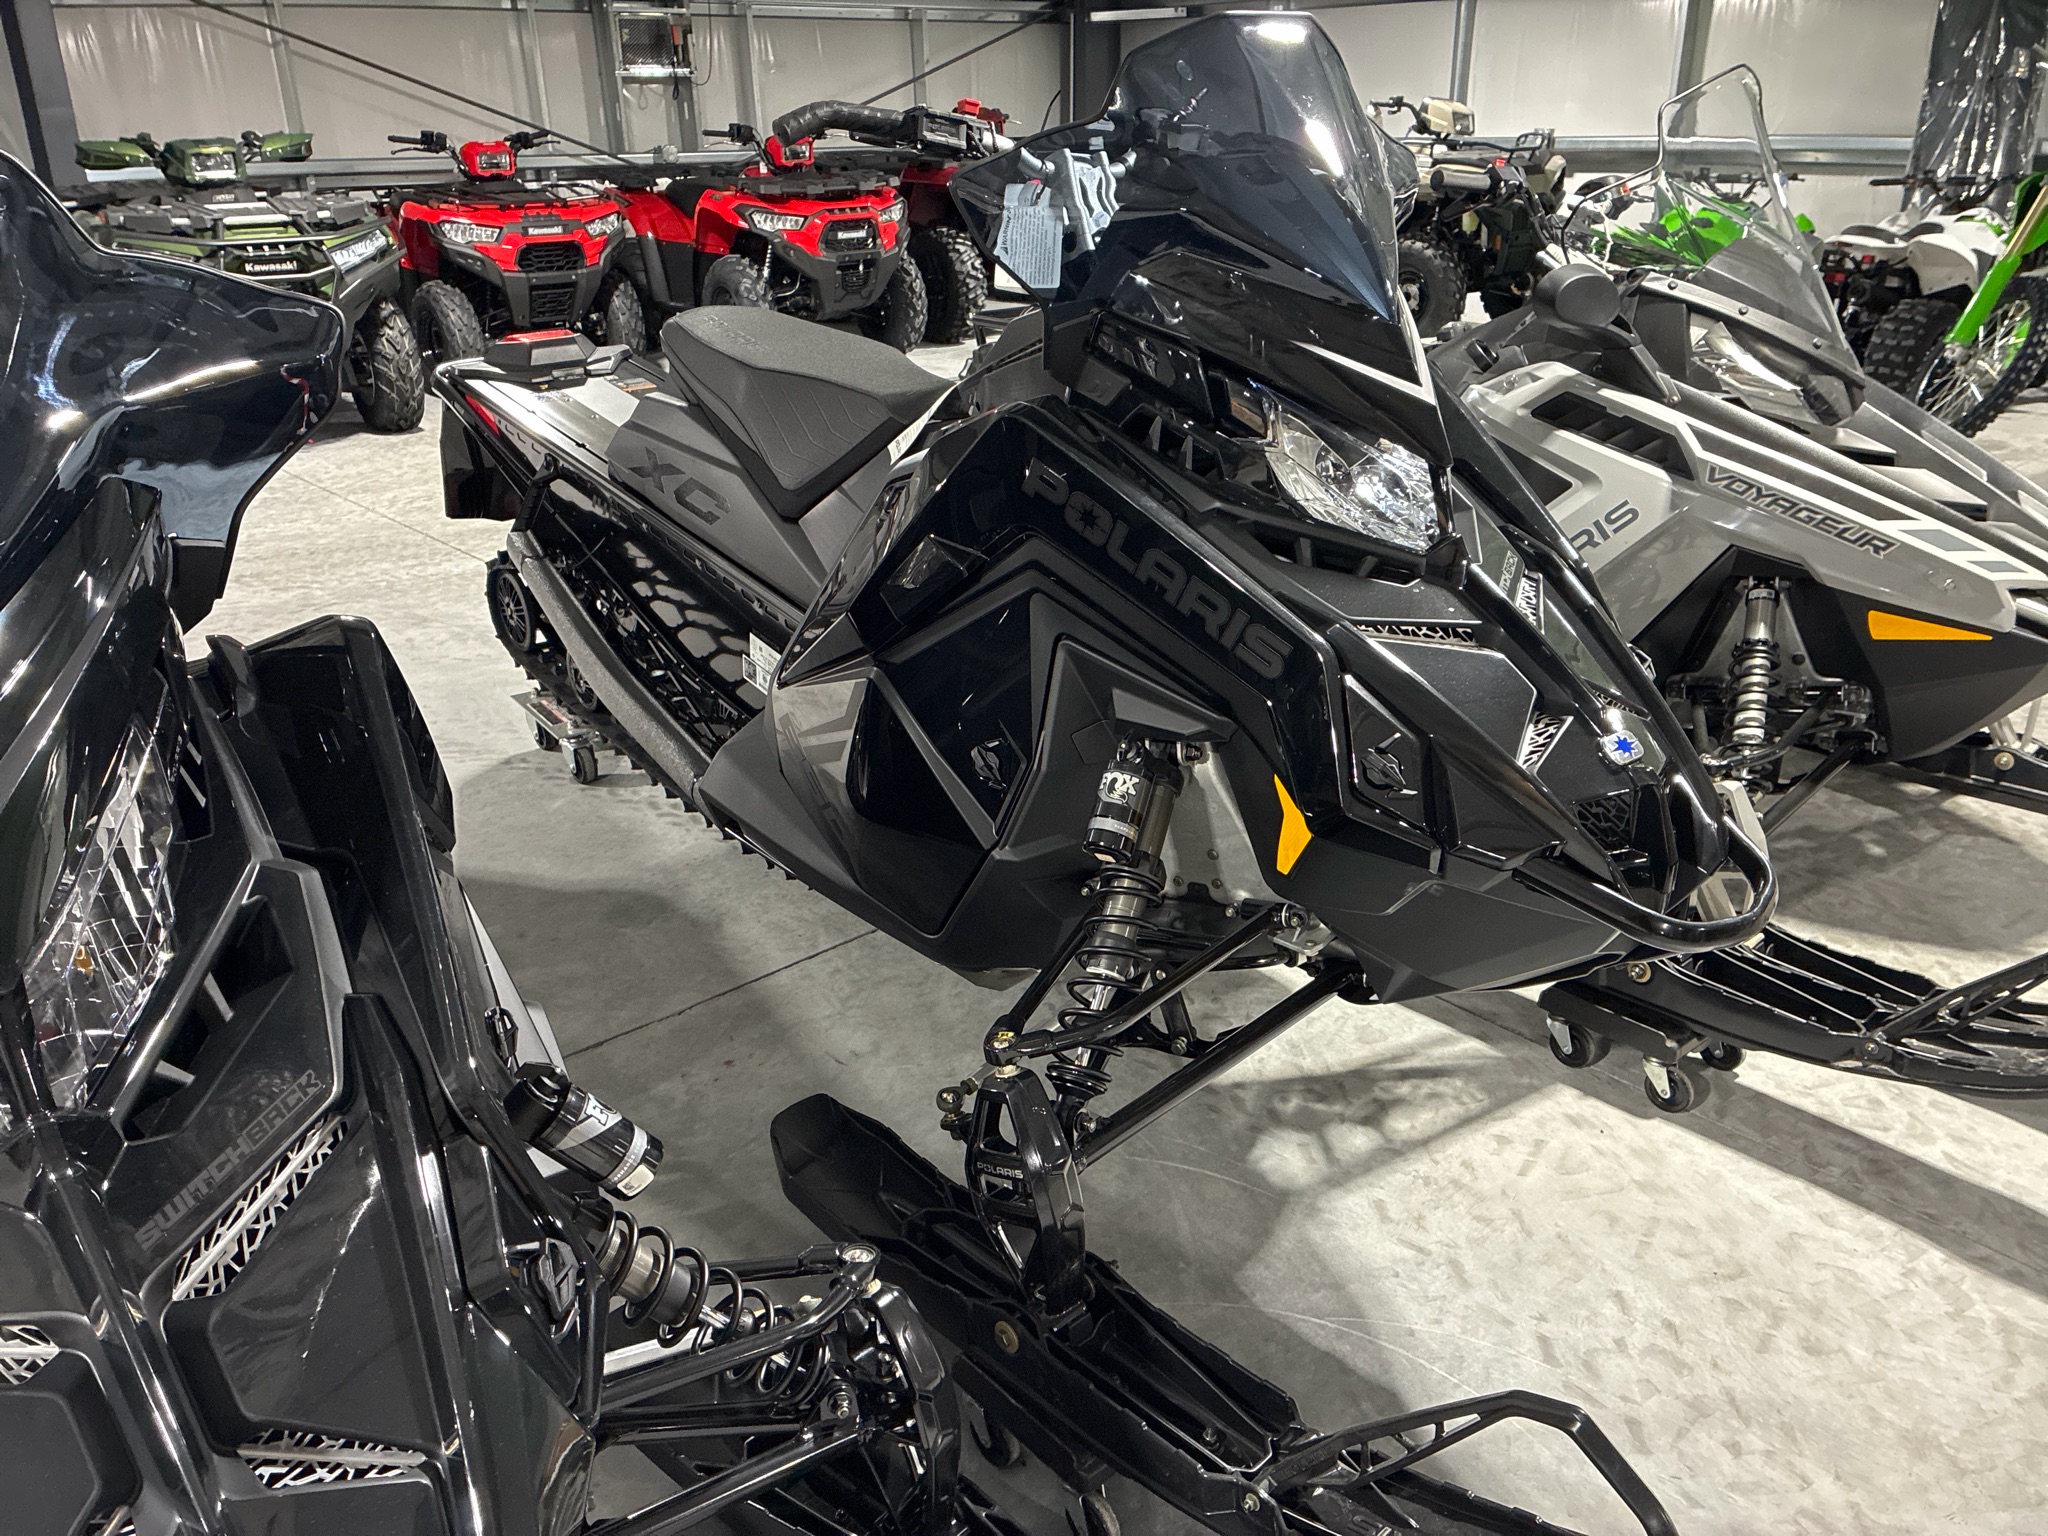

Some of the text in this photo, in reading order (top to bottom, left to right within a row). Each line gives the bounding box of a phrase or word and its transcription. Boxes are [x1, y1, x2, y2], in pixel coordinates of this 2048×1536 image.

[244, 260, 298, 273] Kawasaki
[627, 447, 731, 526] XC
[1706, 463, 1900, 559] VOYAGEUR
[1568, 499, 1640, 552] RIS
[1021, 457, 1294, 680] POLARIS
[1098, 771, 1140, 803] FOX
[133, 1069, 323, 1251] SWITCHBACK
[976, 1161, 1024, 1180] POLARIS
